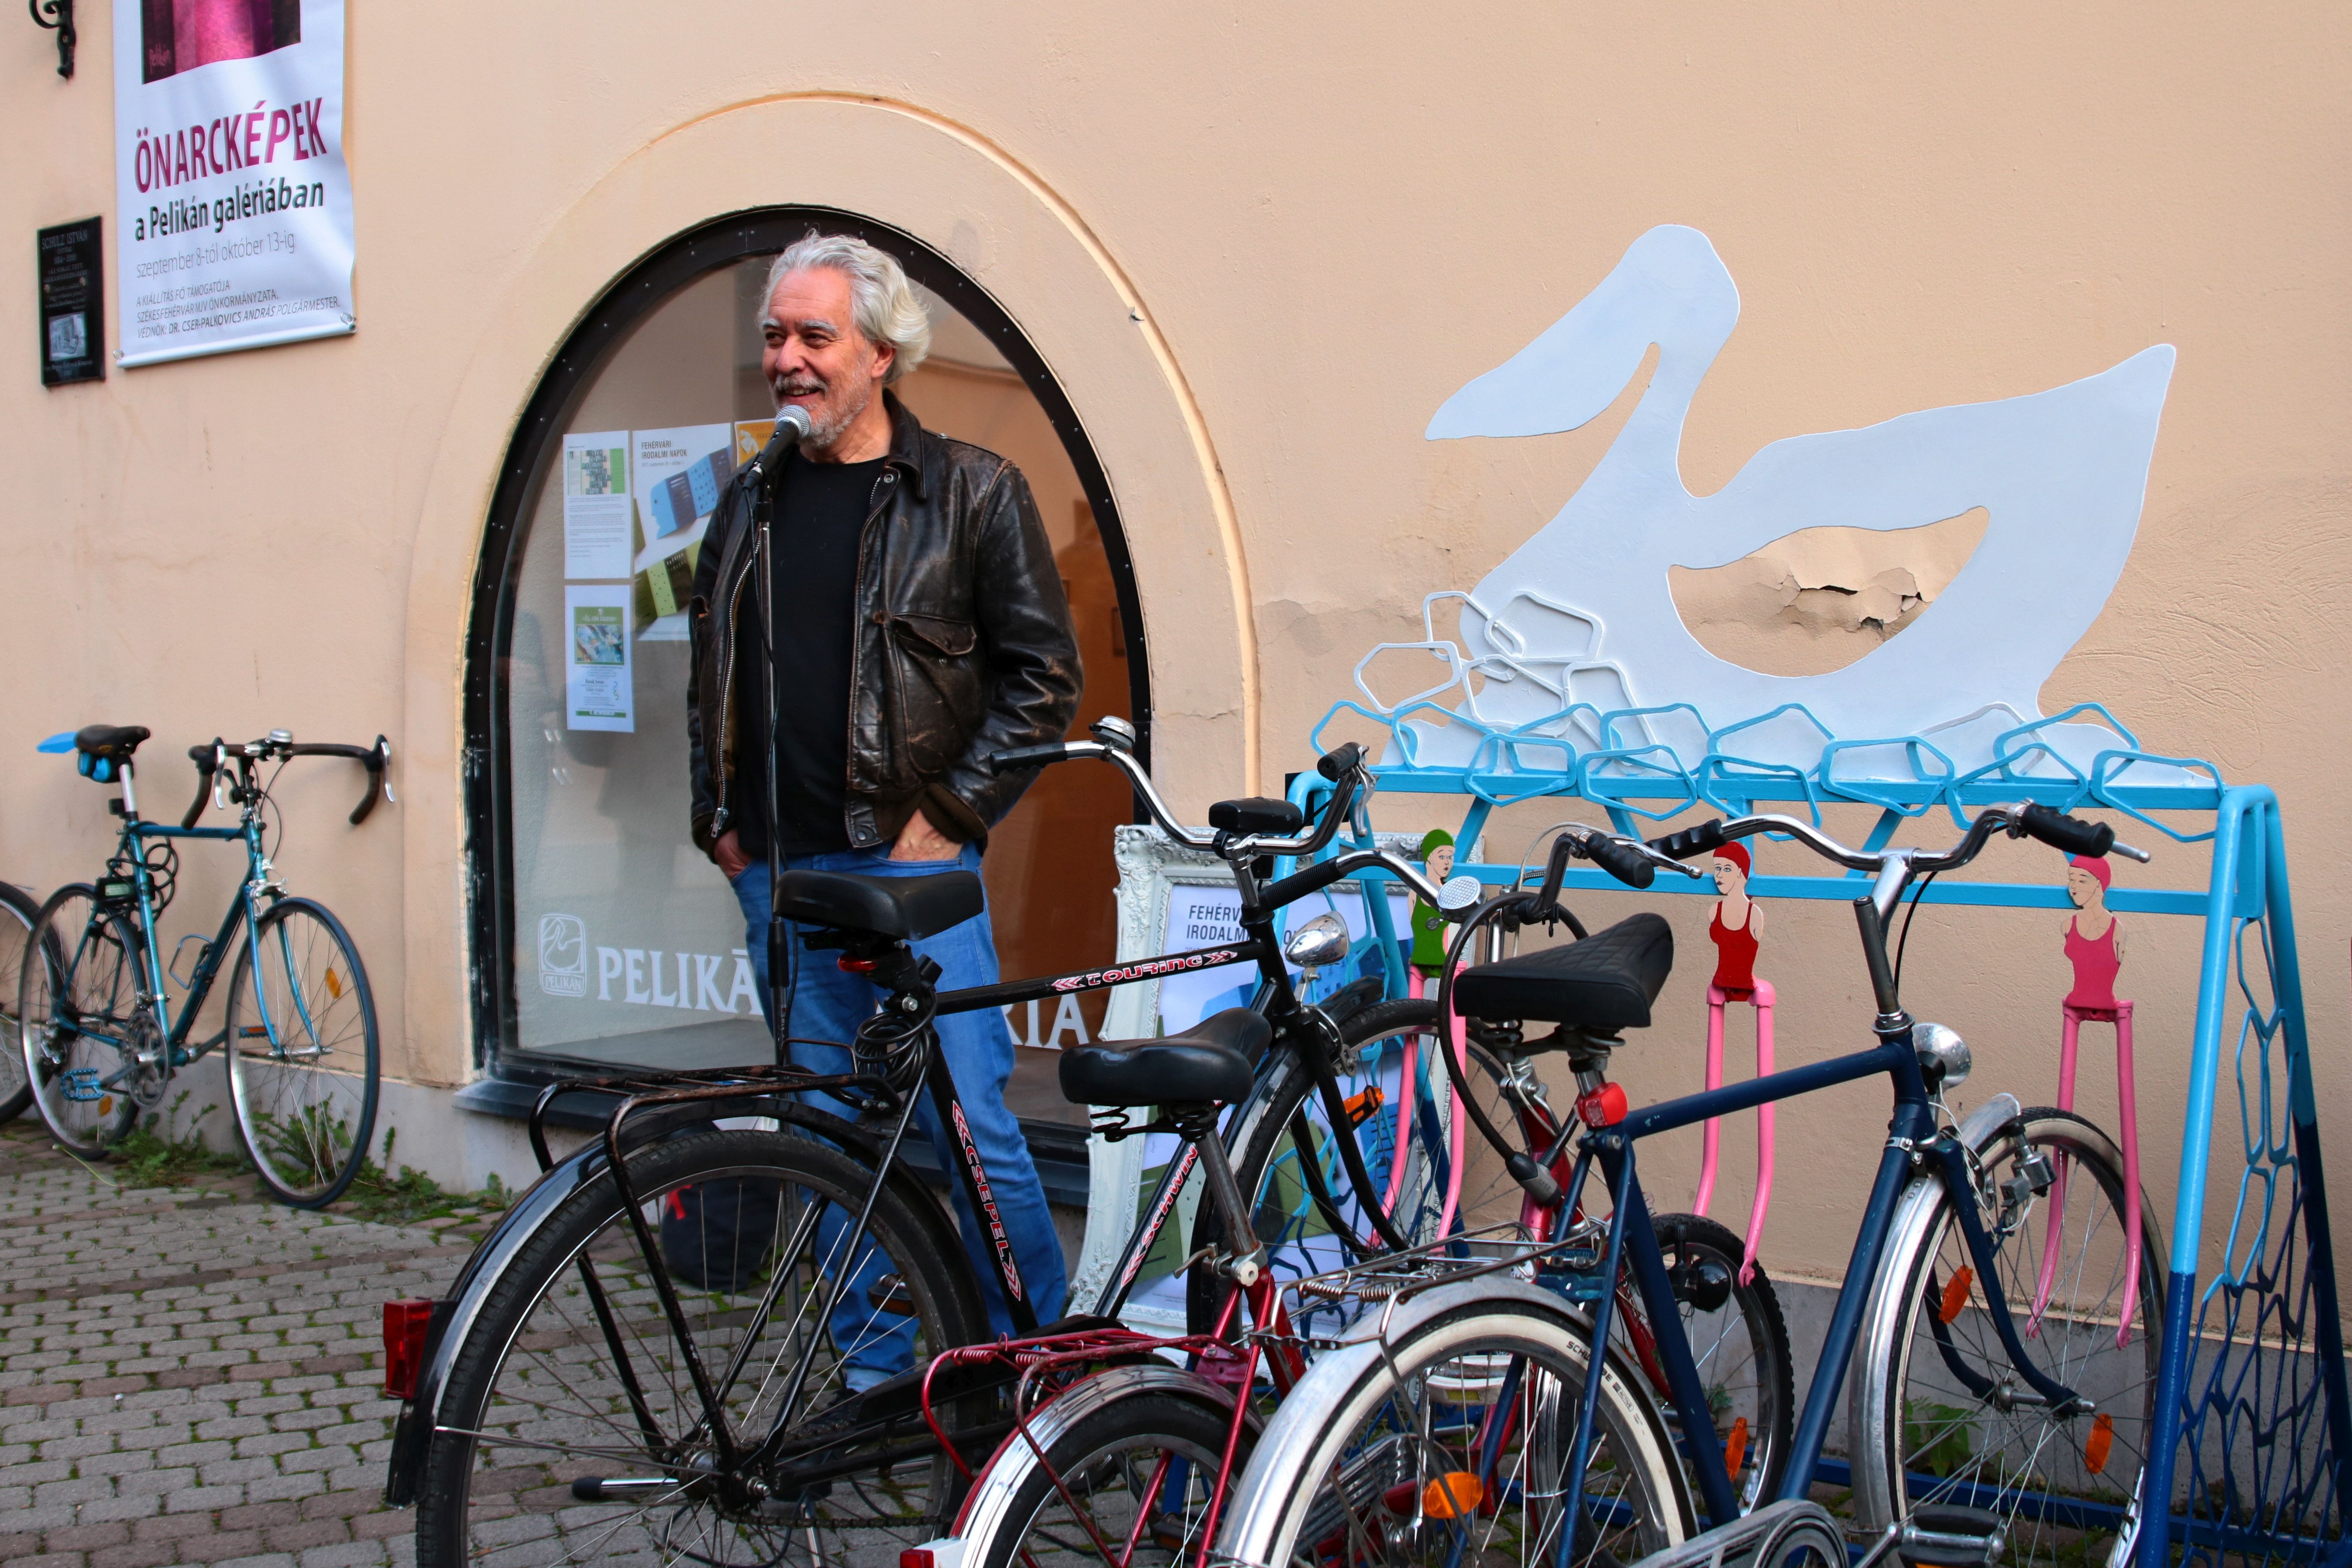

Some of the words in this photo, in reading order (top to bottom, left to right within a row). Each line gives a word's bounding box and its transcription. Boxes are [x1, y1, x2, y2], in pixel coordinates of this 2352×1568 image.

[135, 97, 327, 193] ÖNARCKÉPEK
[135, 217, 144, 241] a
[150, 196, 208, 238] Pelikán
[213, 177, 323, 233] galériában
[137, 251, 194, 280] szeptember
[196, 242, 218, 266] 8-tól
[221, 237, 263, 260] október
[267, 230, 295, 254] 13-ig
[136, 296, 141, 307] A
[143, 288, 174, 306] KIÁLLÍTÁS
[187, 279, 230, 298] TÁMOGATÓJA
[138, 302, 194, 323] SZÉKESFEHÉRVÁR
[196, 300, 208, 313] MJV
[209, 289, 278, 310] ÖNKORMÁNYZATA.
[138, 323, 167, 338] VÉDNÖK:
[169, 322, 180, 334] DR.
[182, 312, 242, 332] CSER-PALKOVICS
[243, 303, 276, 321] ANDRÁS
[276, 296, 340, 315] POLGÁRMESTER.
[641, 439, 671, 449] FEHÉRVÁRI
[641, 451, 668, 459] IRODALMI
[669, 449, 687, 457] NAPOK
[1189, 903, 1240, 922] FEHÉRV
[966, 1146, 1009, 1262] CSEPEL
[1141, 1143, 1198, 1249] SCHWIN
